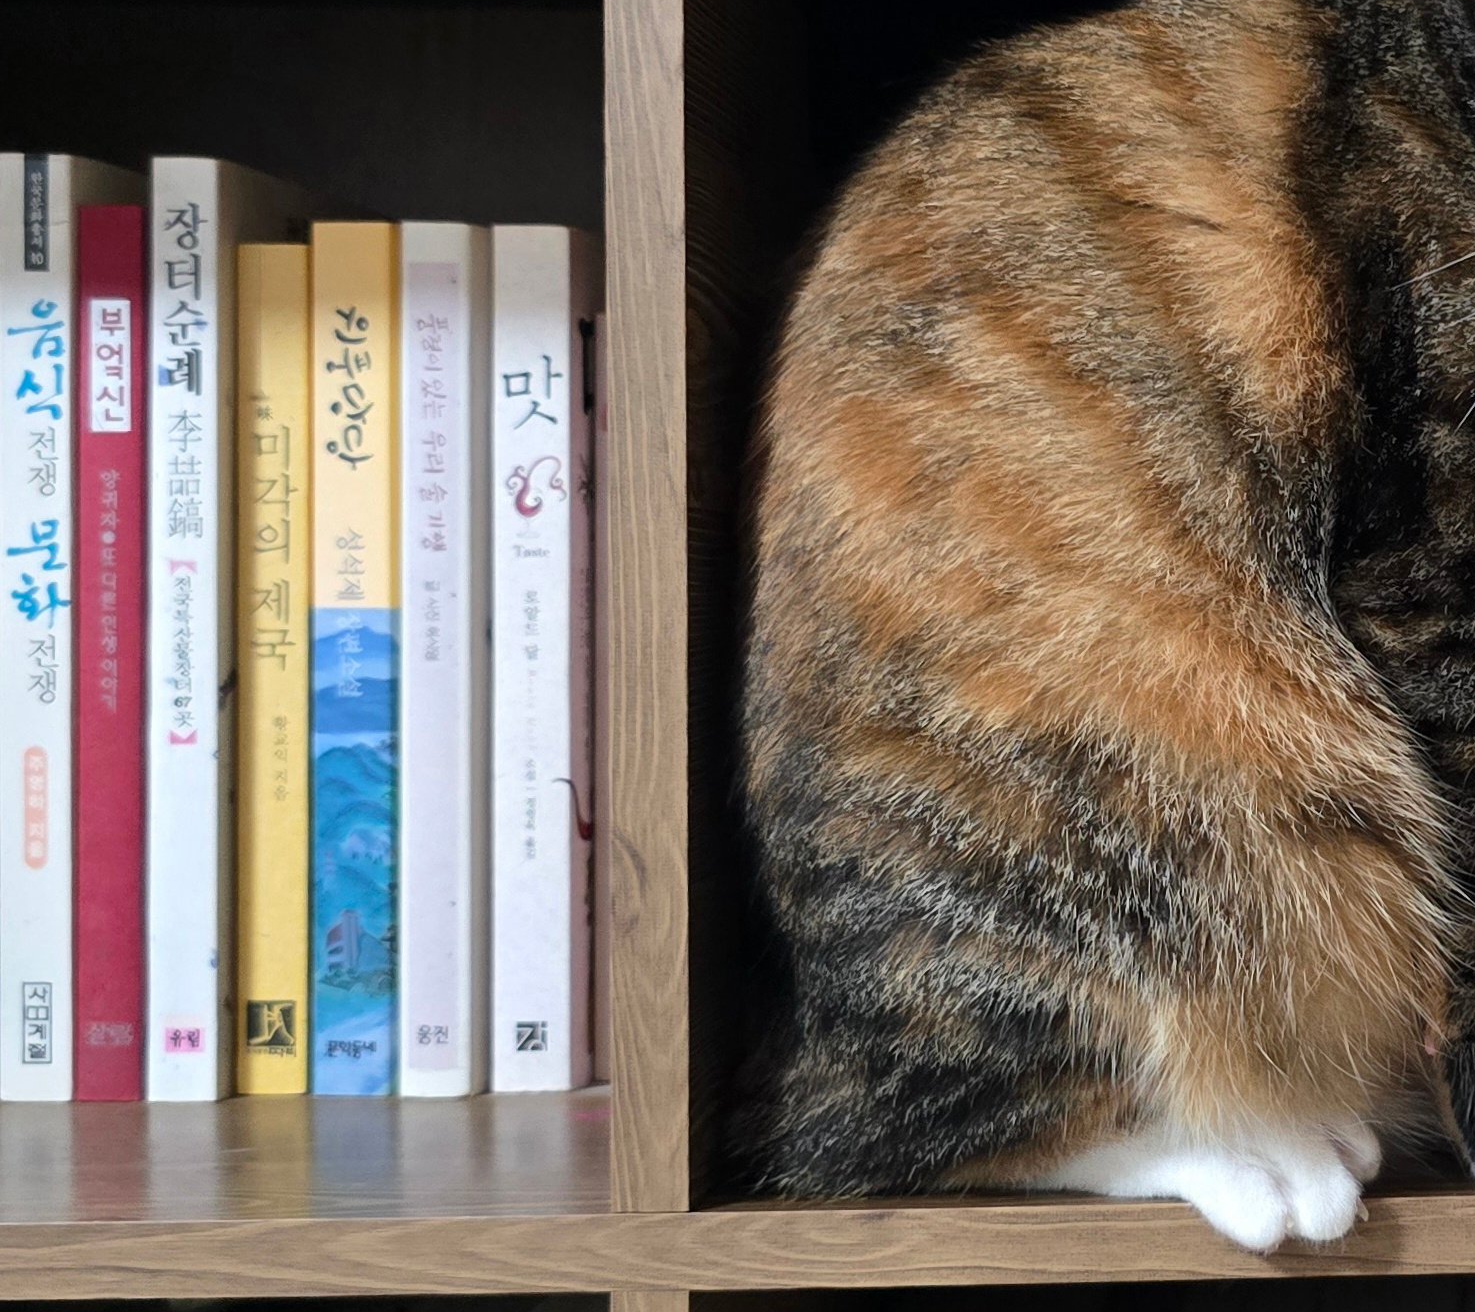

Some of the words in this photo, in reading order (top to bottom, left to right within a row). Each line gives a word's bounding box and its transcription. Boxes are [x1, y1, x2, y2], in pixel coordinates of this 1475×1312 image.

[163, 202, 209, 397] 장터순례
[97, 308, 126, 422] 부엌신
[327, 304, 374, 472] 위풍당당
[420, 379, 448, 419] 있는
[502, 355, 564, 430] 맛
[422, 432, 447, 474] 우리
[251, 424, 300, 564] 미각의
[513, 544, 550, 559] Taste
[251, 578, 297, 672] 제국
[170, 1027, 201, 1050] 유림
[417, 1025, 449, 1045] 웅진
